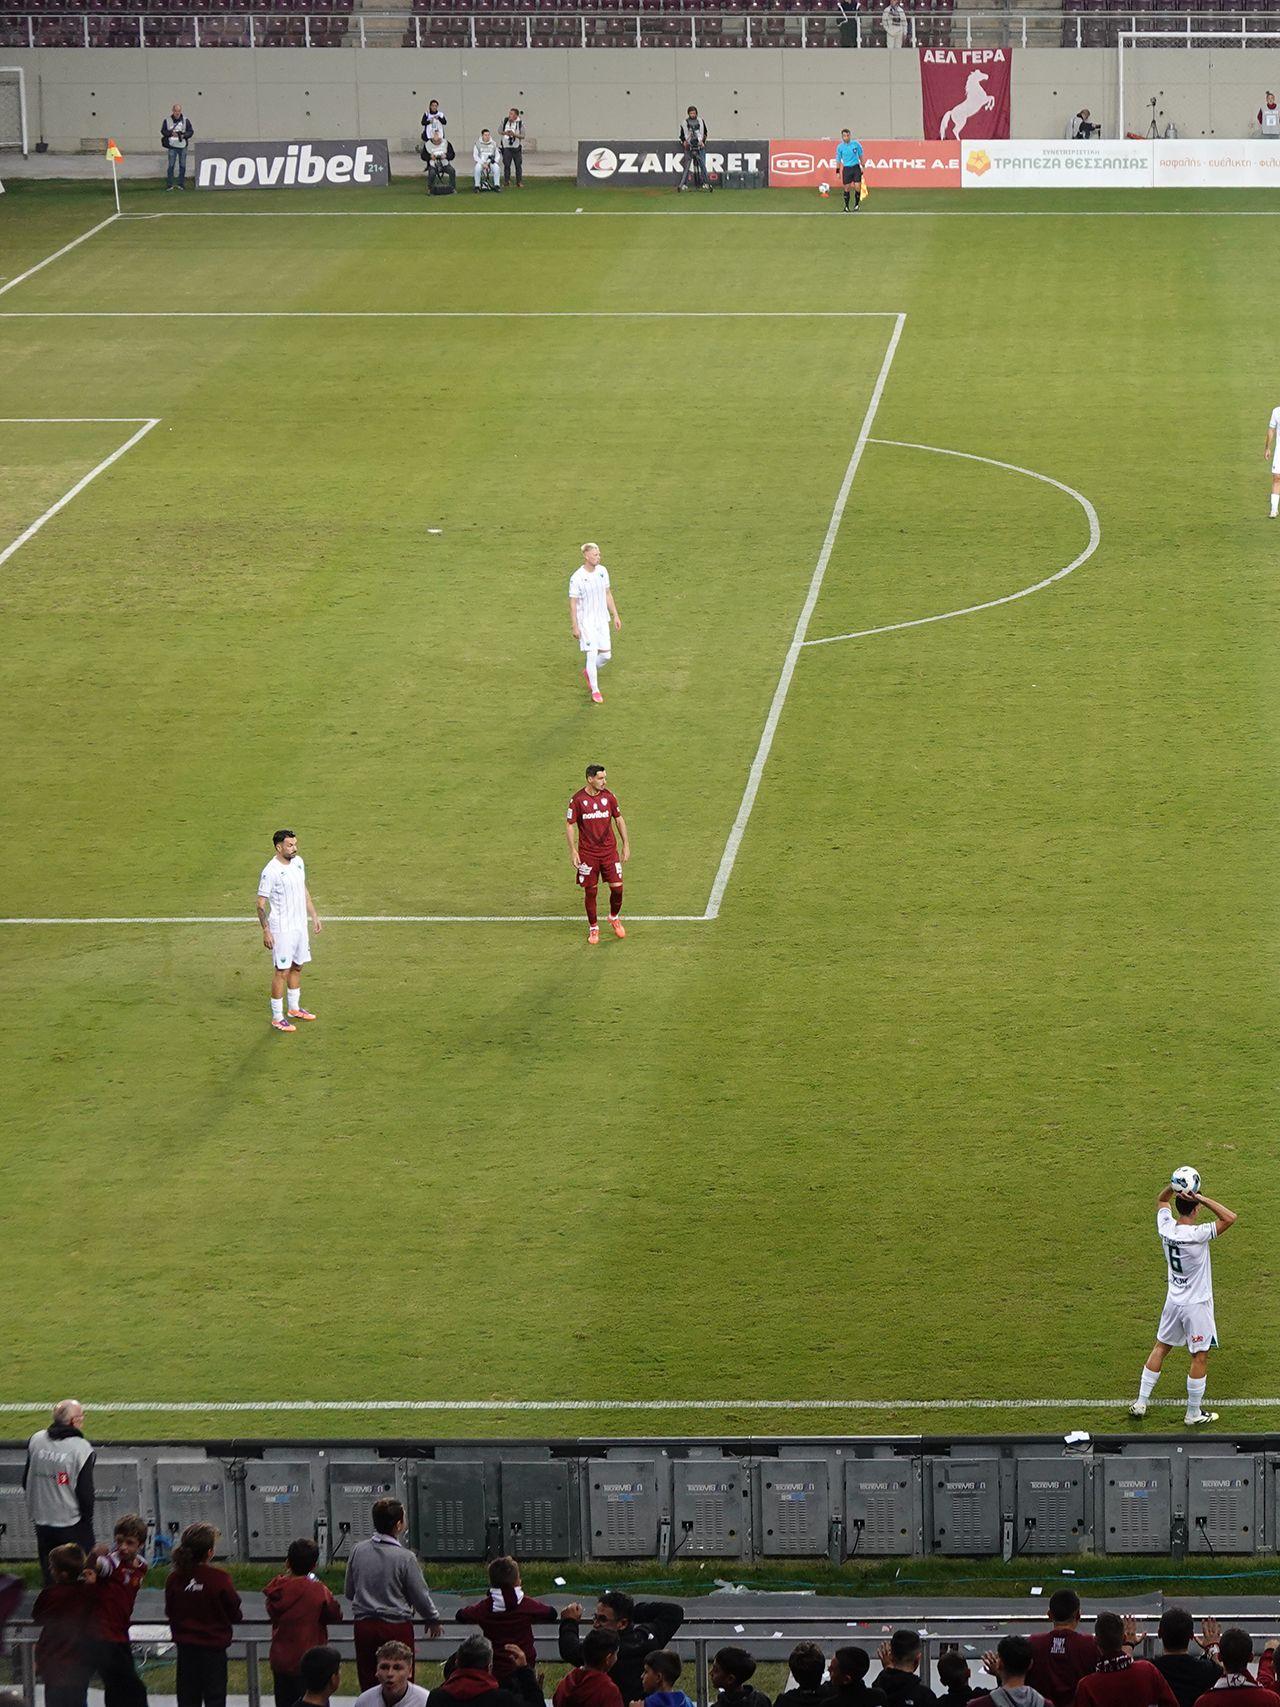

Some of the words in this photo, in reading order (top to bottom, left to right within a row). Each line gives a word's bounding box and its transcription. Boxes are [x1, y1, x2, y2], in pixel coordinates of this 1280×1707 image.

[923, 49, 957, 63] ΑΕΛ
[962, 49, 1005, 63] ΓΕΡΑ
[198, 144, 374, 186] novibet
[367, 163, 384, 173] 21+
[618, 153, 761, 173] ZAKRET
[776, 159, 810, 169] GTC
[816, 158, 926, 169] ΛΕΑΔΙΤΗΣ
[994, 158, 1061, 169] ΤΡΑΠΕΖΑ
[582, 810, 610, 820] novibet
